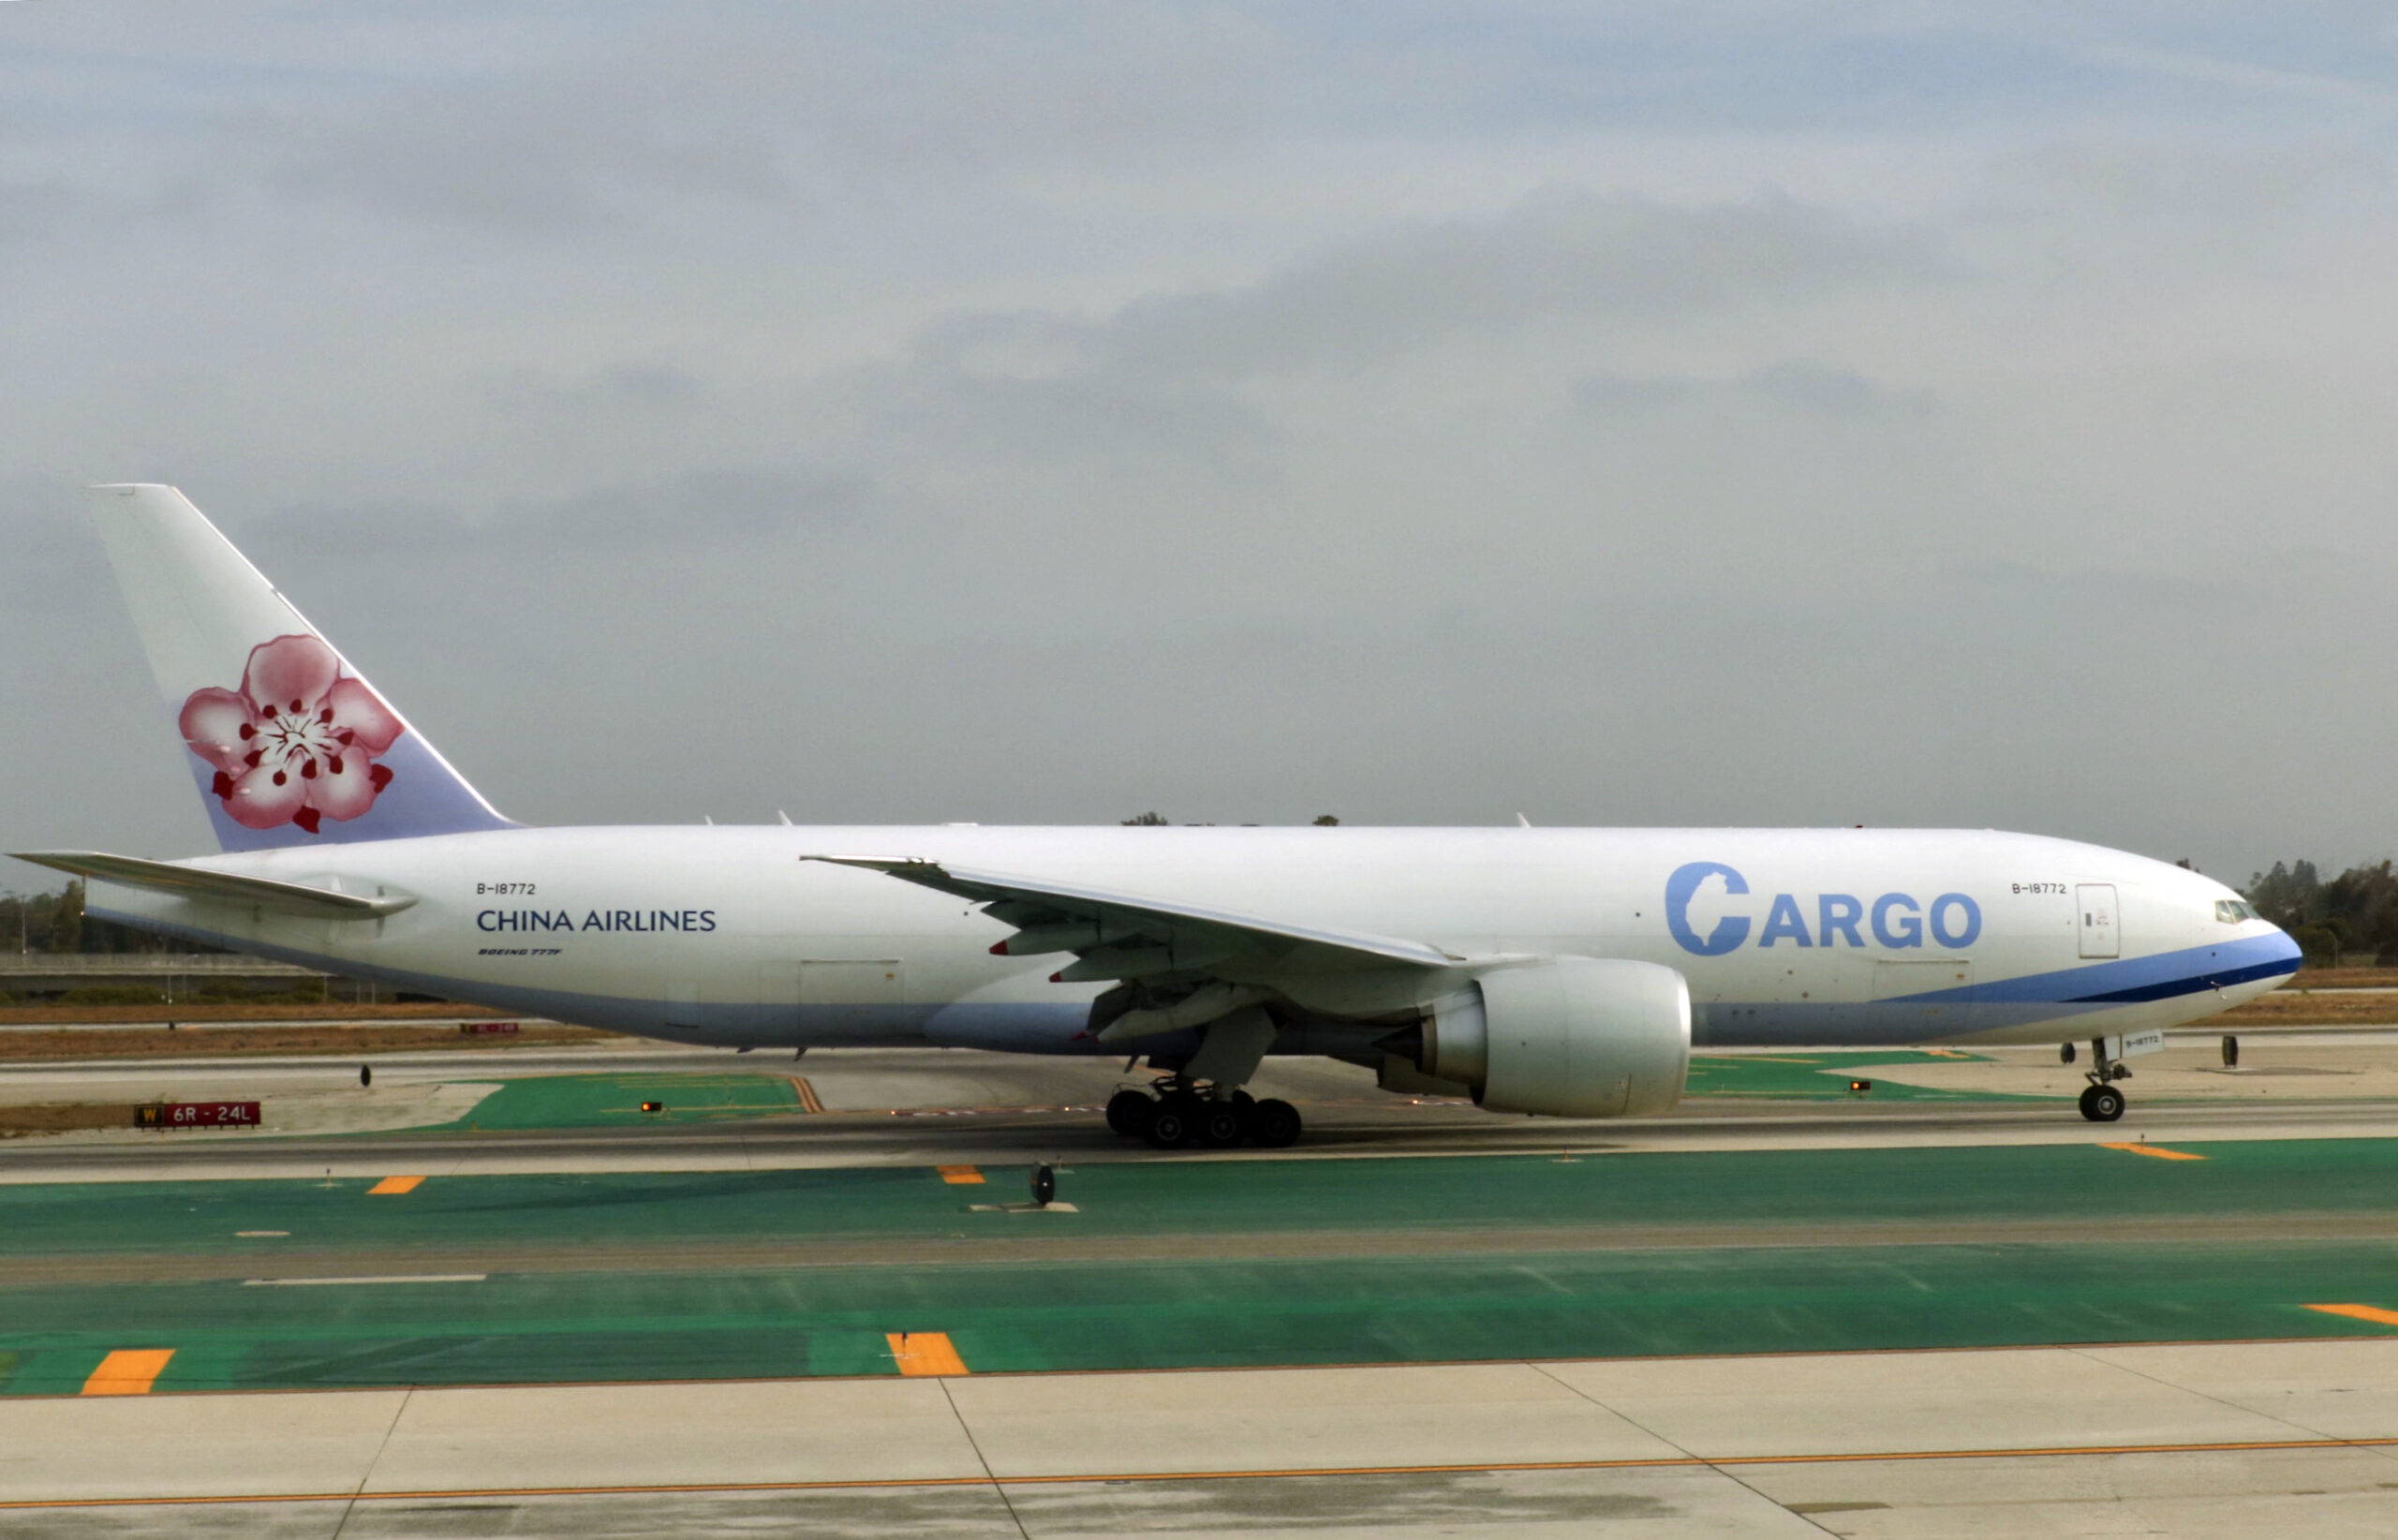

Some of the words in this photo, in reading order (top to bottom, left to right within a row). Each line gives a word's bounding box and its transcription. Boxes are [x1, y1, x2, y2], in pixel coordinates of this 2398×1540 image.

[476, 882, 536, 895] B-18772
[2011, 883, 2066, 894] B-18772
[1665, 861, 1982, 956] CARGO
[477, 910, 573, 932] CHINA
[581, 910, 717, 932] AIRLINES
[2125, 1035, 2159, 1048] B-18772
[143, 1108, 156, 1122] W
[173, 1107, 197, 1122] 6R
[217, 1105, 251, 1121] 24L
